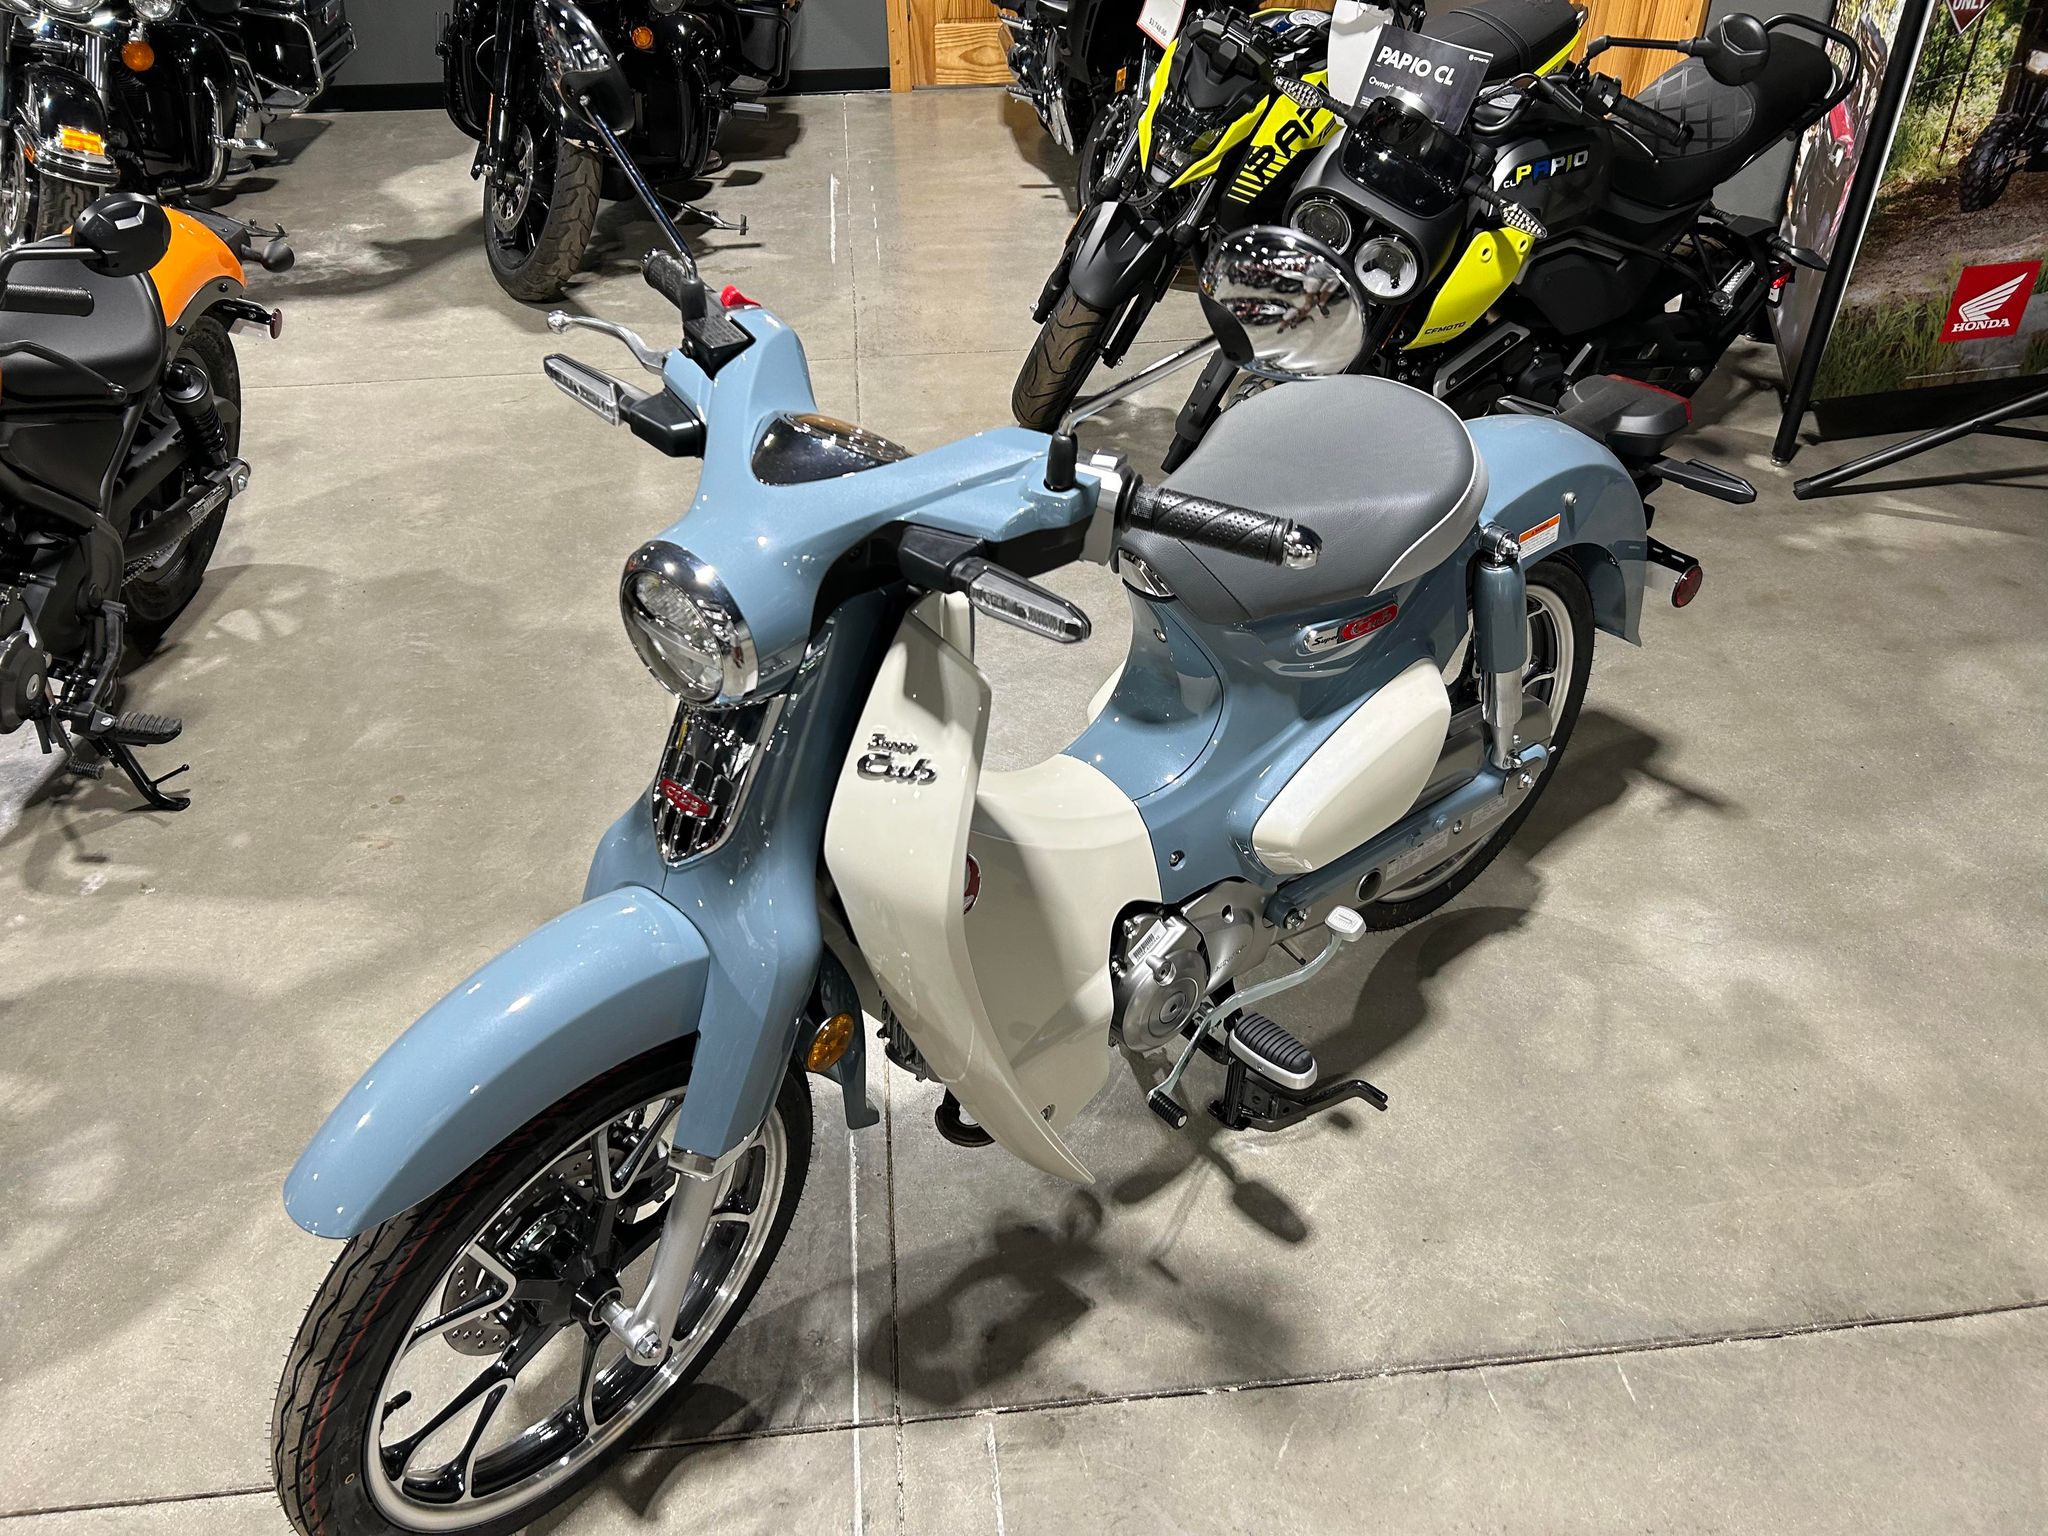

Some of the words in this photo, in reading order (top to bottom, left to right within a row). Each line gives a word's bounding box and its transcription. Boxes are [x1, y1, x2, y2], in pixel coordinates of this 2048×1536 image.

[1377, 45, 1432, 77] PAPIO
[1434, 65, 1455, 86] CL
[1516, 150, 1589, 186] PAPIO
[1424, 321, 1467, 335] CFMOTO
[1951, 318, 2011, 333] HONDA
[857, 752, 937, 786] Cub
